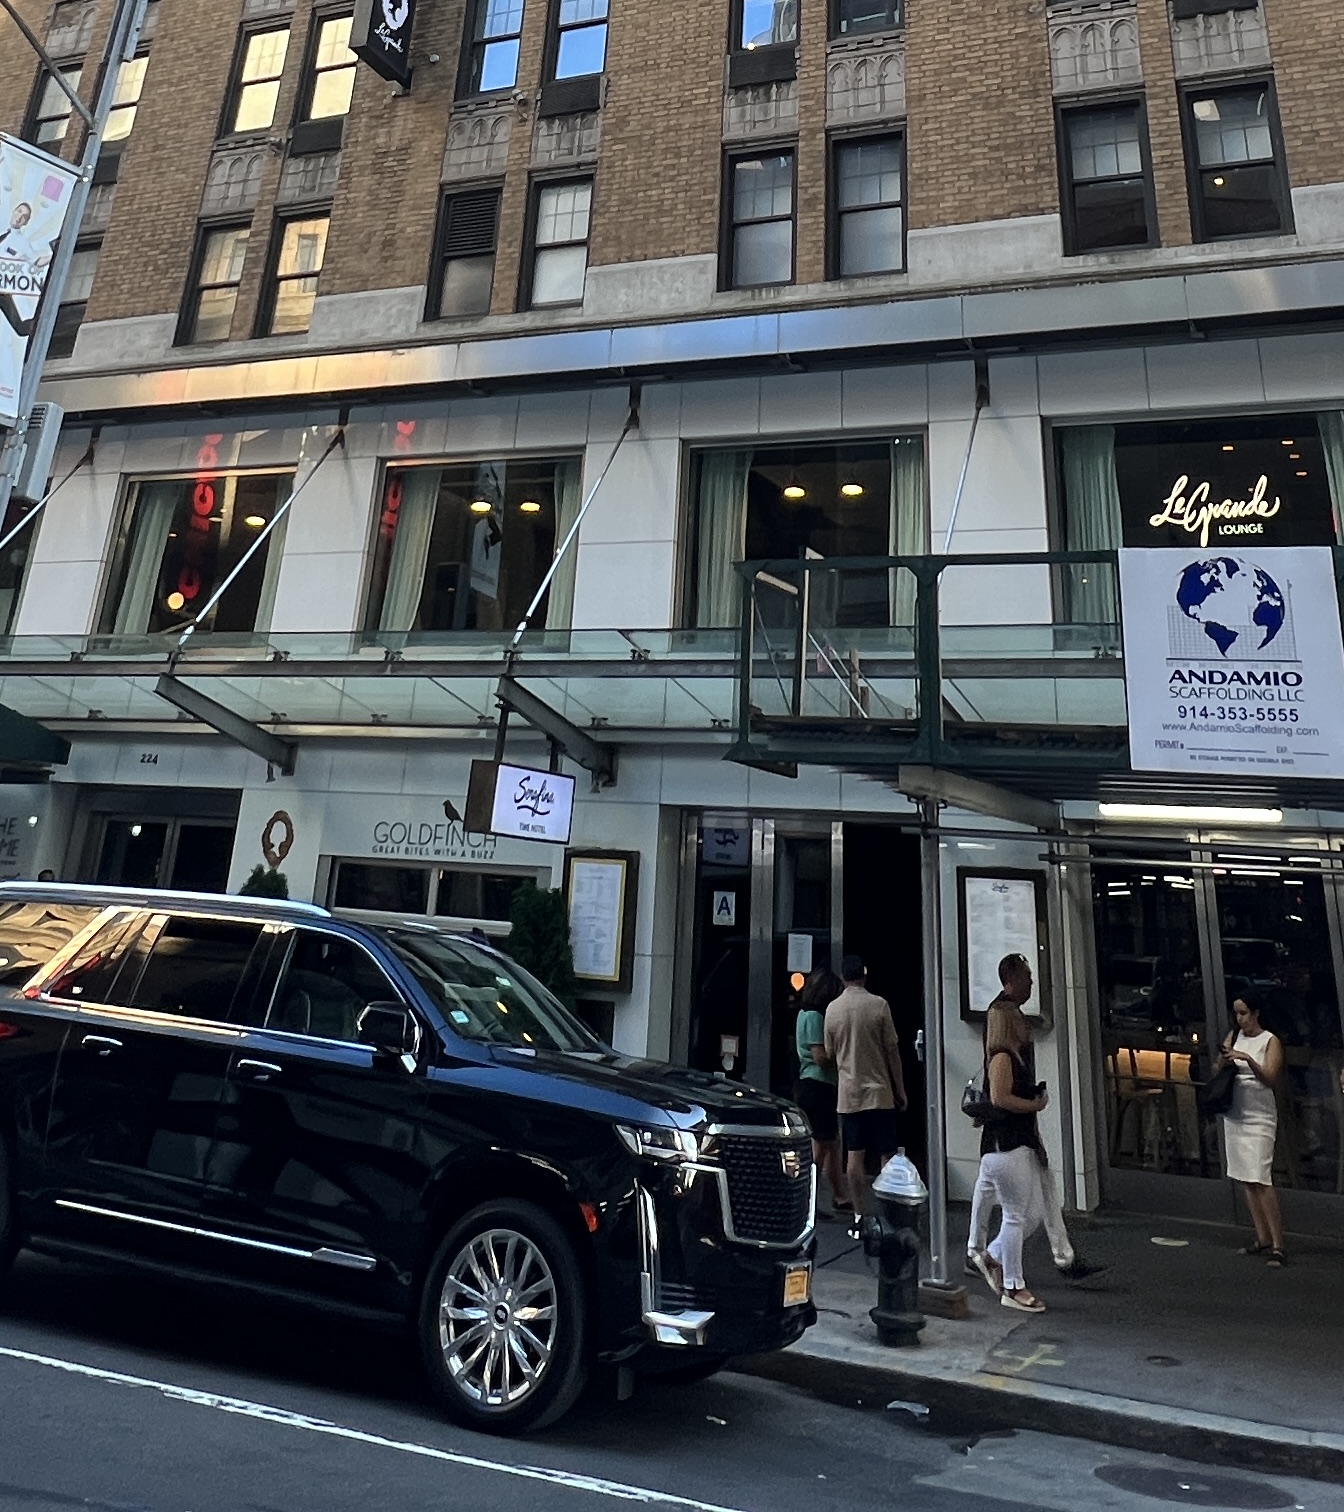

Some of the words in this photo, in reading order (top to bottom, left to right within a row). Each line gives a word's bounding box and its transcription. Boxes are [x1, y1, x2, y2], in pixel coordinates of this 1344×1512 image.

[1218, 523, 1264, 535] LOUNGE
[1169, 669, 1303, 687] ANDAMIO
[1169, 686, 1274, 701] SCAFFOLDING
[1278, 688, 1306, 702] LLC
[1178, 705, 1299, 723] 914-353-5555
[1162, 722, 1320, 737] www.AndamioScaffolding.com
[140, 753, 159, 765] 224
[372, 845, 400, 855] GREAT
[404, 846, 429, 856] BITES
[433, 848, 456, 857] WITH
[460, 849, 466, 858] A
[471, 850, 495, 859] BUZZ
[716, 895, 731, 916] A
